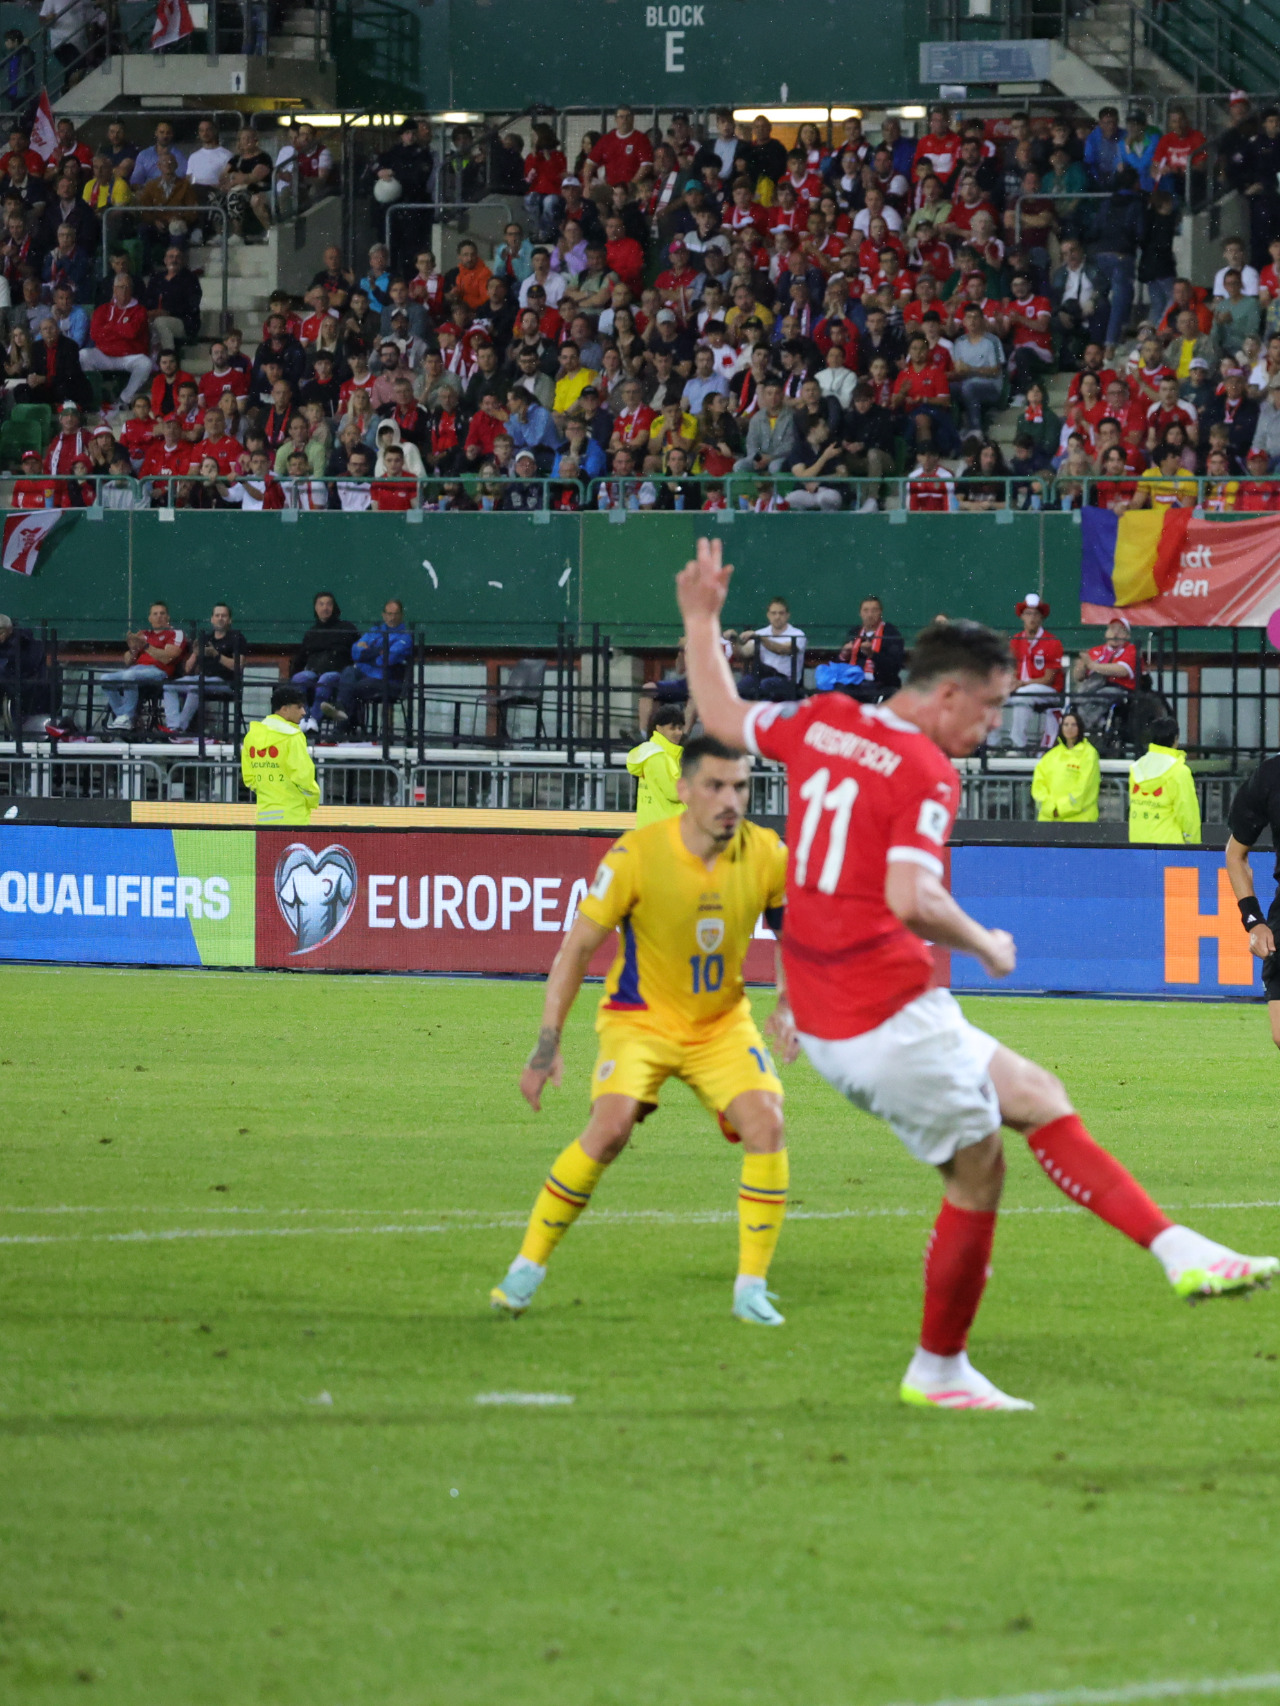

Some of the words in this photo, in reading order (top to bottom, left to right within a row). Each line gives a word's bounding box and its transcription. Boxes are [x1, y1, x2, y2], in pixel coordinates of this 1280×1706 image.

[646, 5, 704, 26] BLOCK
[665, 30, 685, 72] E
[1163, 572, 1209, 597] ien
[795, 766, 859, 895] 11
[0, 871, 230, 920] QUALIFIERS
[690, 954, 724, 994] 10
